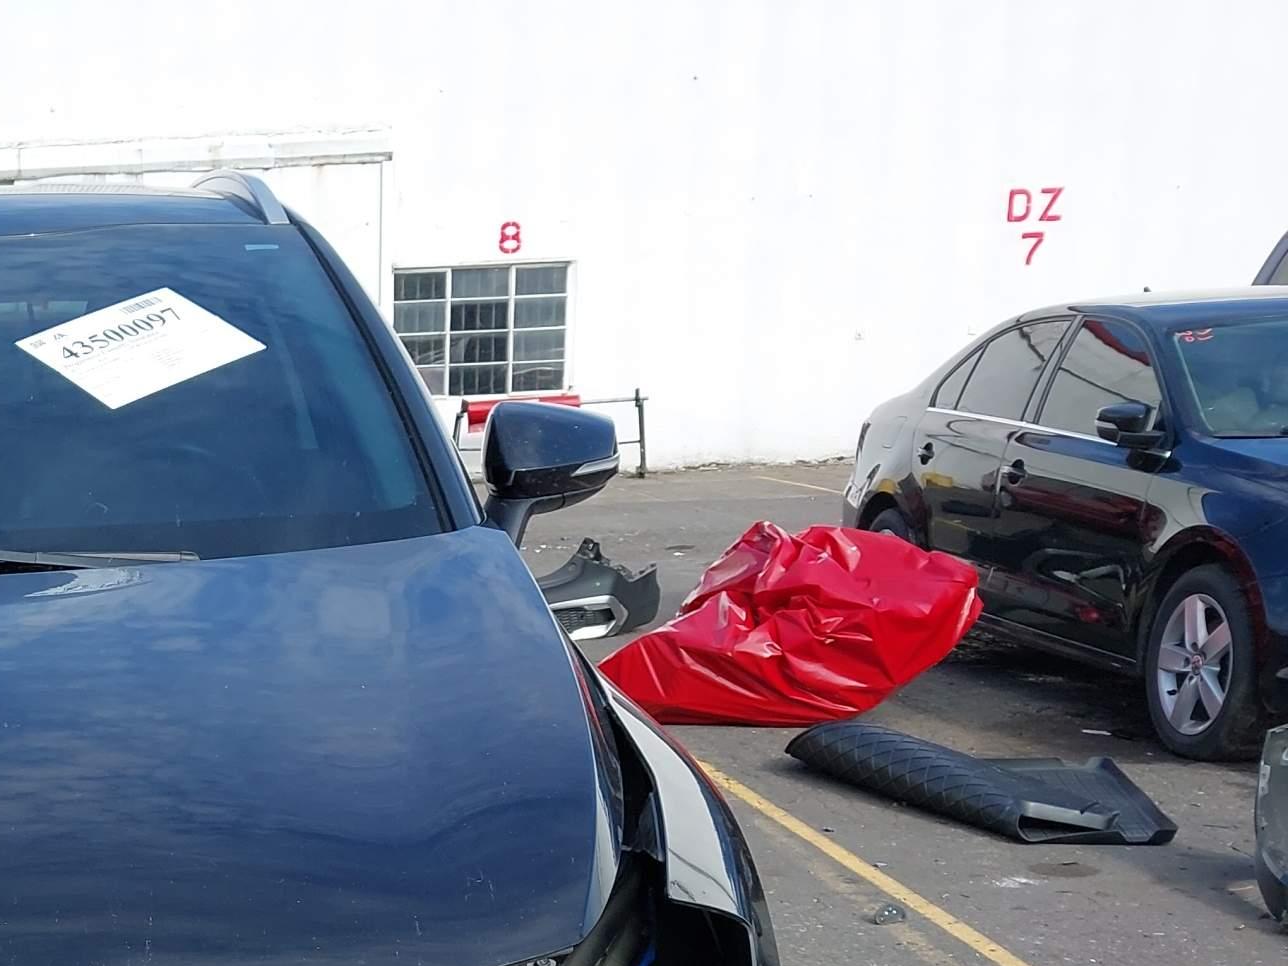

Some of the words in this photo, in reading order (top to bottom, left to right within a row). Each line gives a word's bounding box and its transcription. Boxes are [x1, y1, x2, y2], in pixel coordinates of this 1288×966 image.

[1007, 187, 1064, 222] DZ
[498, 221, 521, 254] 8
[1021, 232, 1044, 265] 7
[62, 307, 181, 360] 43500097
